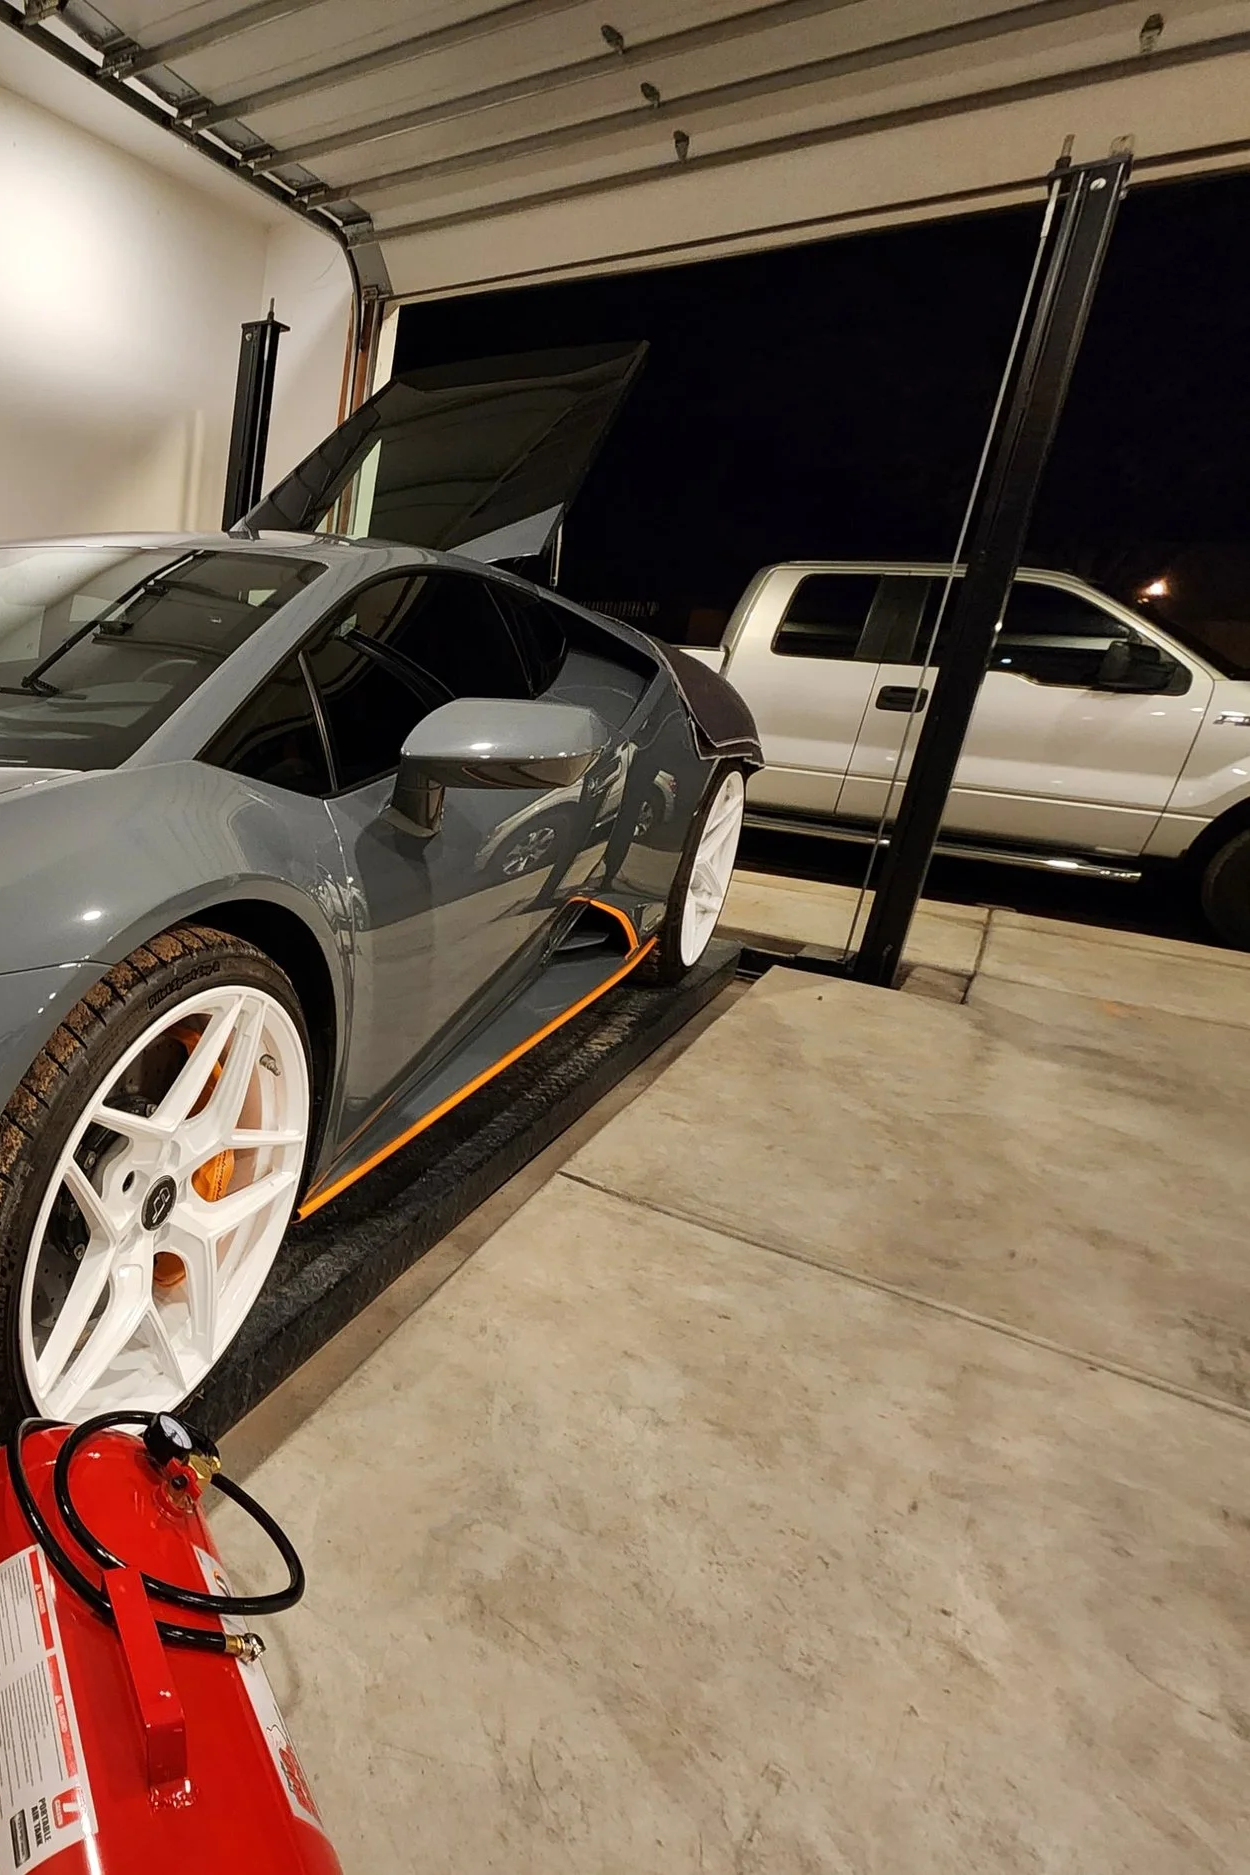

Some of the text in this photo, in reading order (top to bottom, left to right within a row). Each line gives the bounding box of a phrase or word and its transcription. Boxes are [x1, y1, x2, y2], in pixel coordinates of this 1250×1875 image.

[31, 1805, 43, 1848] AIR TANK
[39, 1797, 51, 1842] PORTABLE
